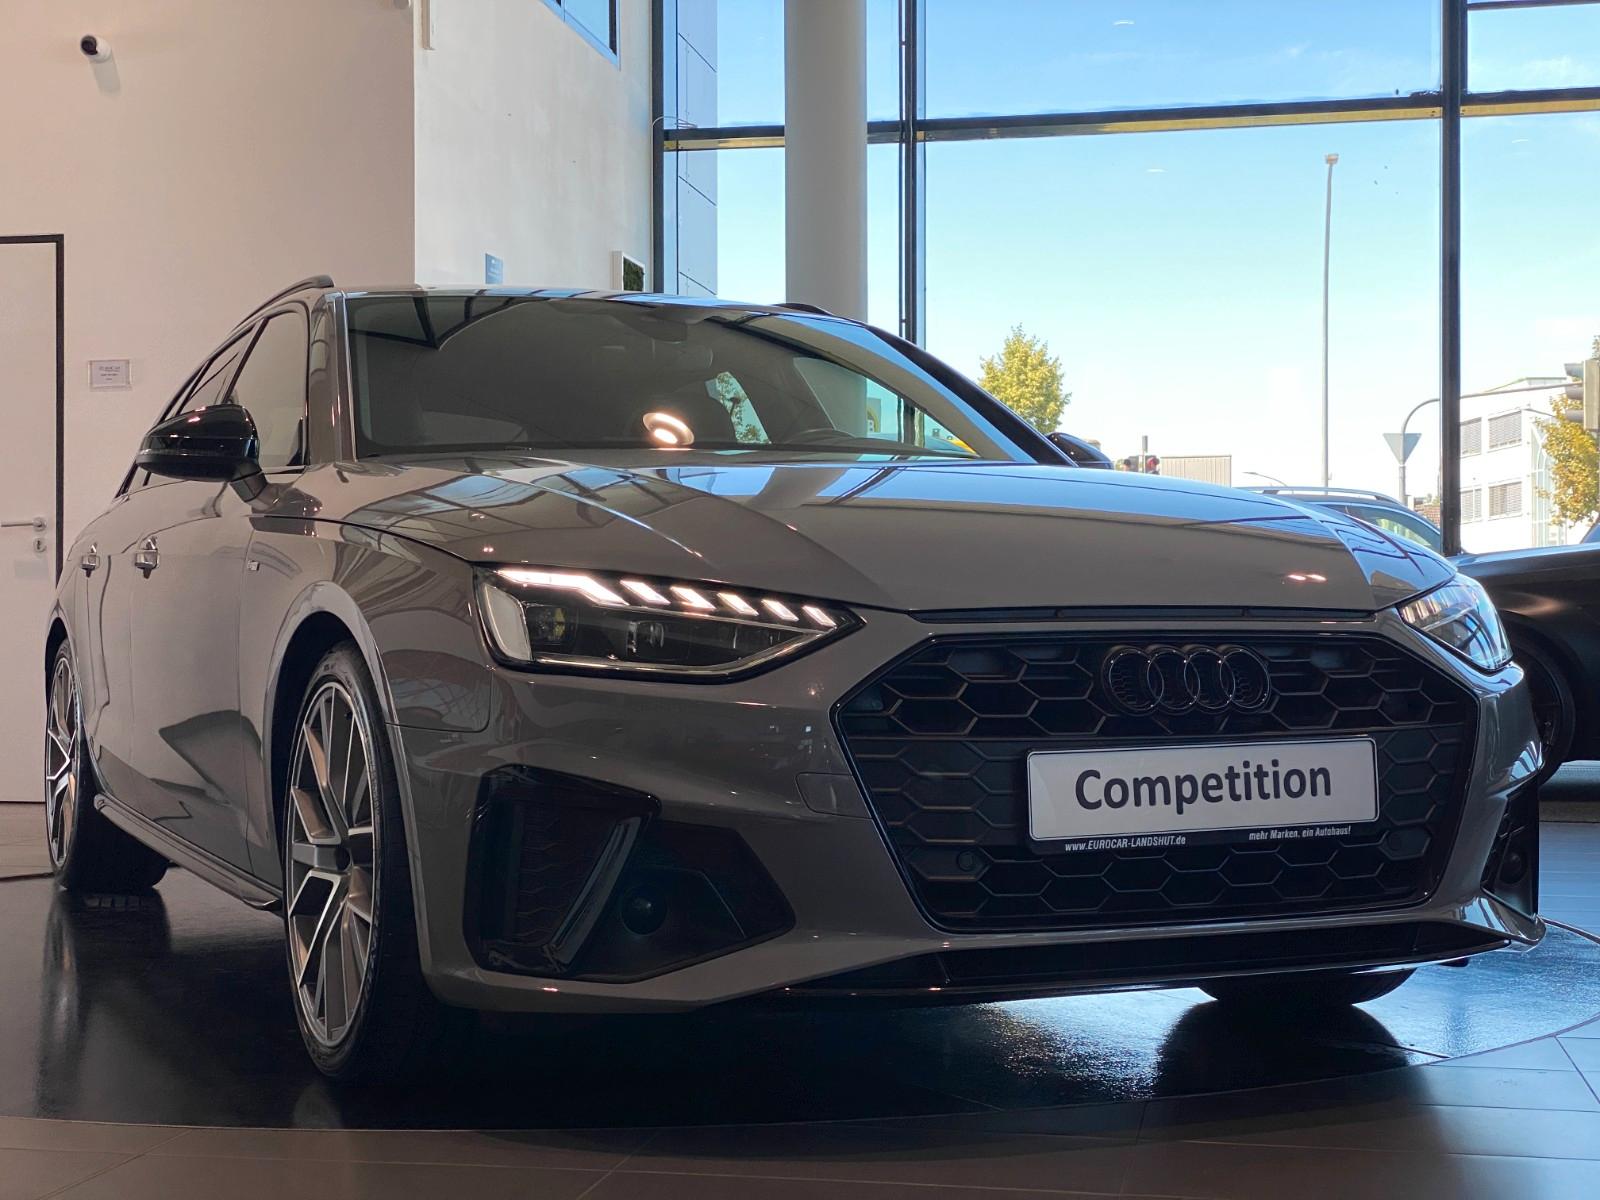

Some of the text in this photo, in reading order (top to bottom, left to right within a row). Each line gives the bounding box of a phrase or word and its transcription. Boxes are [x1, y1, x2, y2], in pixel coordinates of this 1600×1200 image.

[1075, 759, 1331, 815] Competition
[1248, 830, 1268, 841] mehr
[1302, 827, 1313, 838] ein
[1314, 825, 1351, 837] Autohaus!
[1065, 835, 1186, 851] www.EUROCAR-LANDSHUT.de
